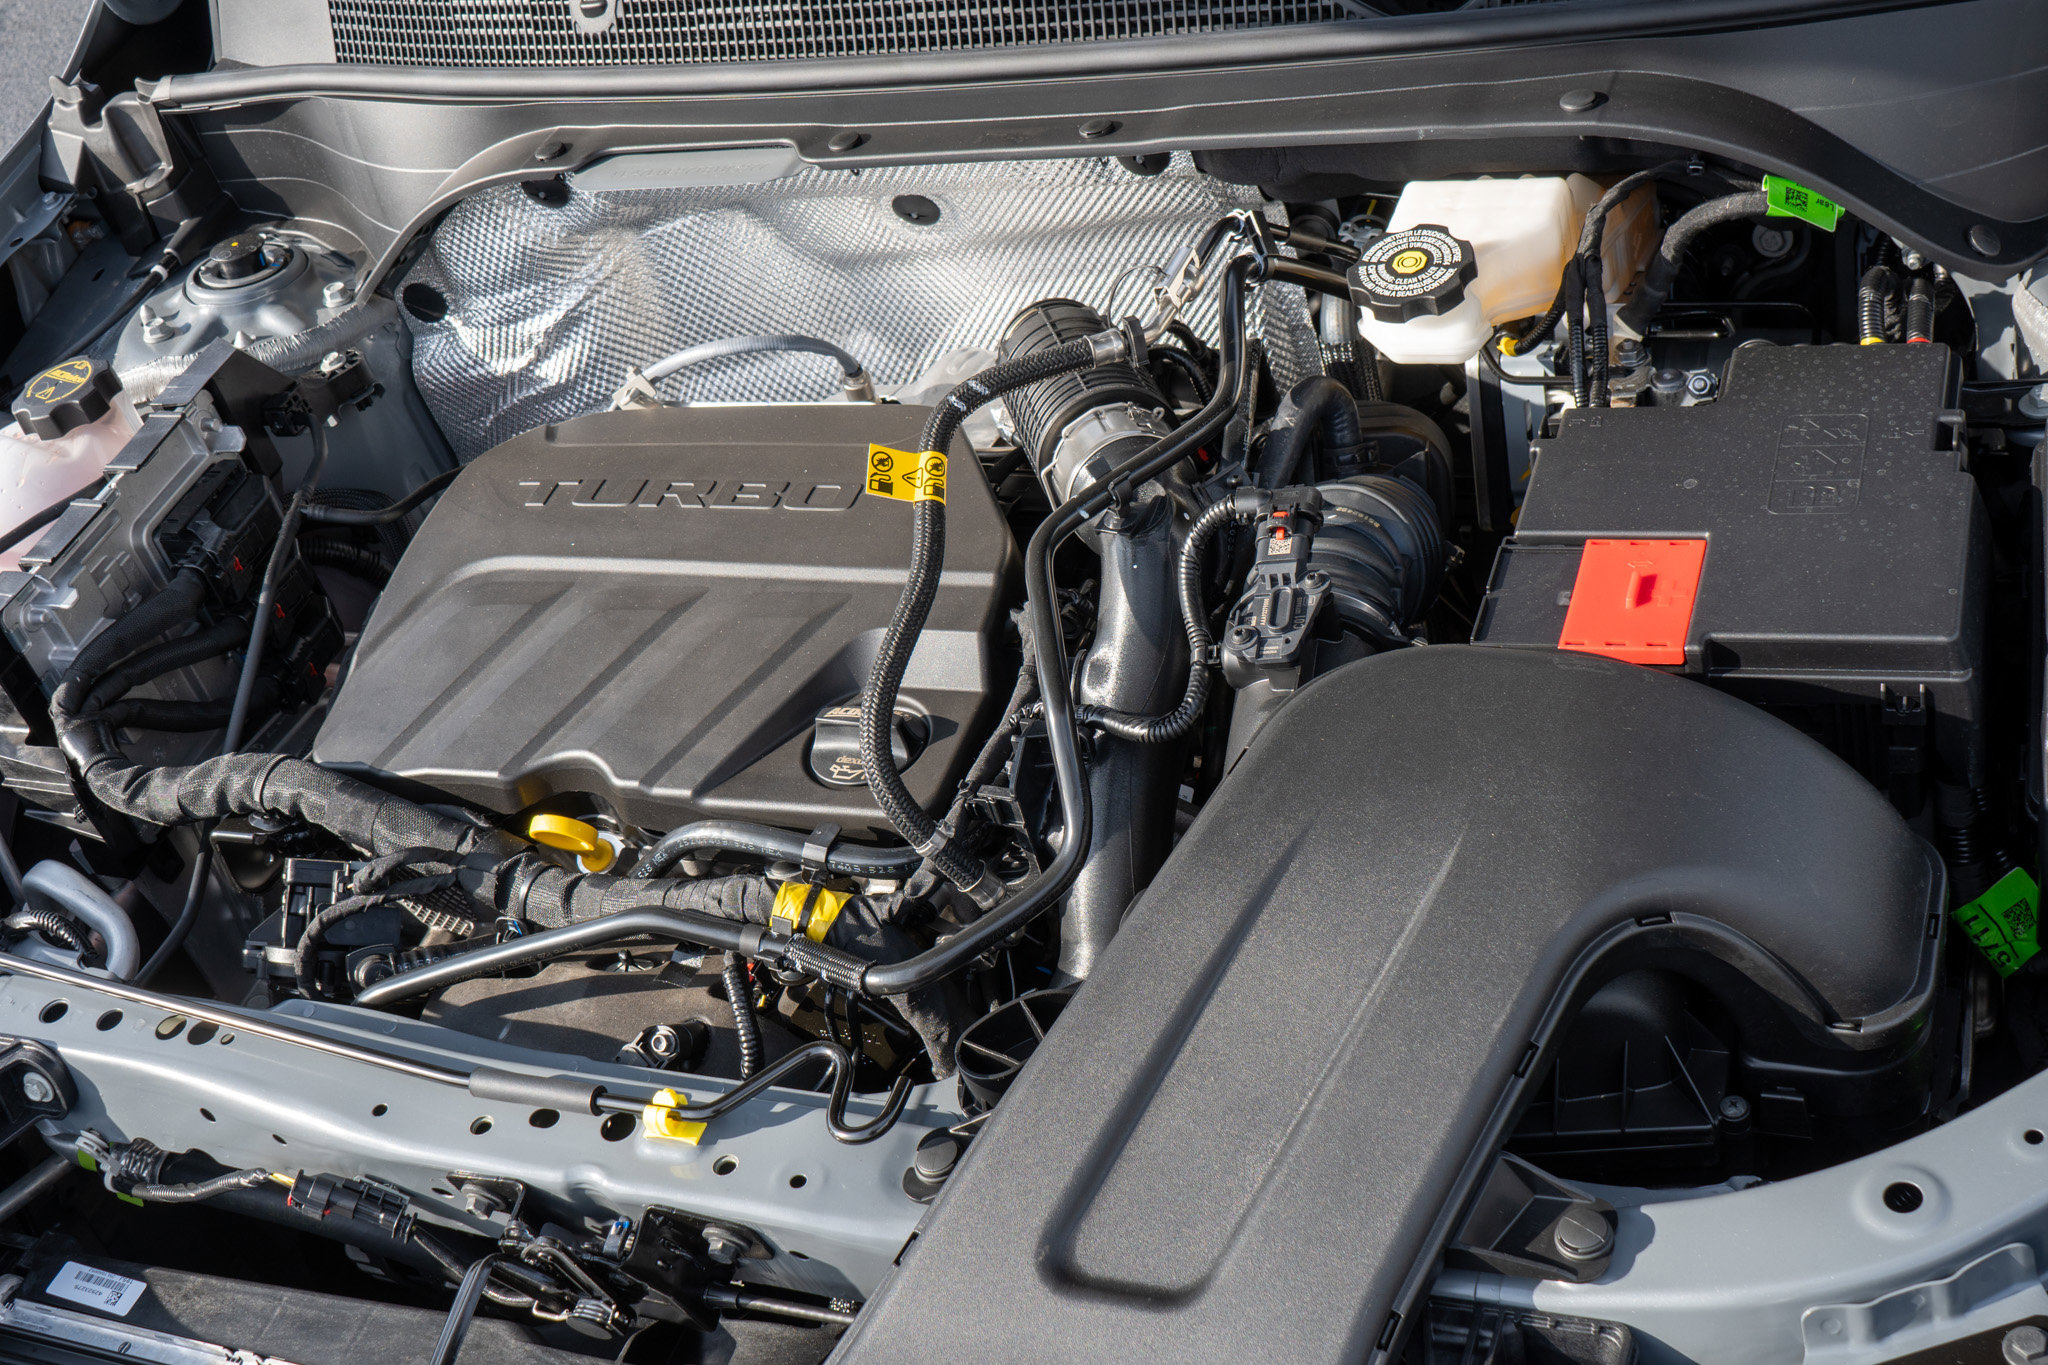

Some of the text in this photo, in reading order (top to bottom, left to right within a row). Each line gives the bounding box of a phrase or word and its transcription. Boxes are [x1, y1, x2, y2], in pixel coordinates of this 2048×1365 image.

[1815, 198, 1834, 211] Lear
[1393, 276, 1418, 284] CLEAN
[1417, 265, 1439, 281] FILLER
[1371, 285, 1392, 296] FROM
[1395, 287, 1424, 297] SEALED
[519, 479, 865, 511] TURBO
